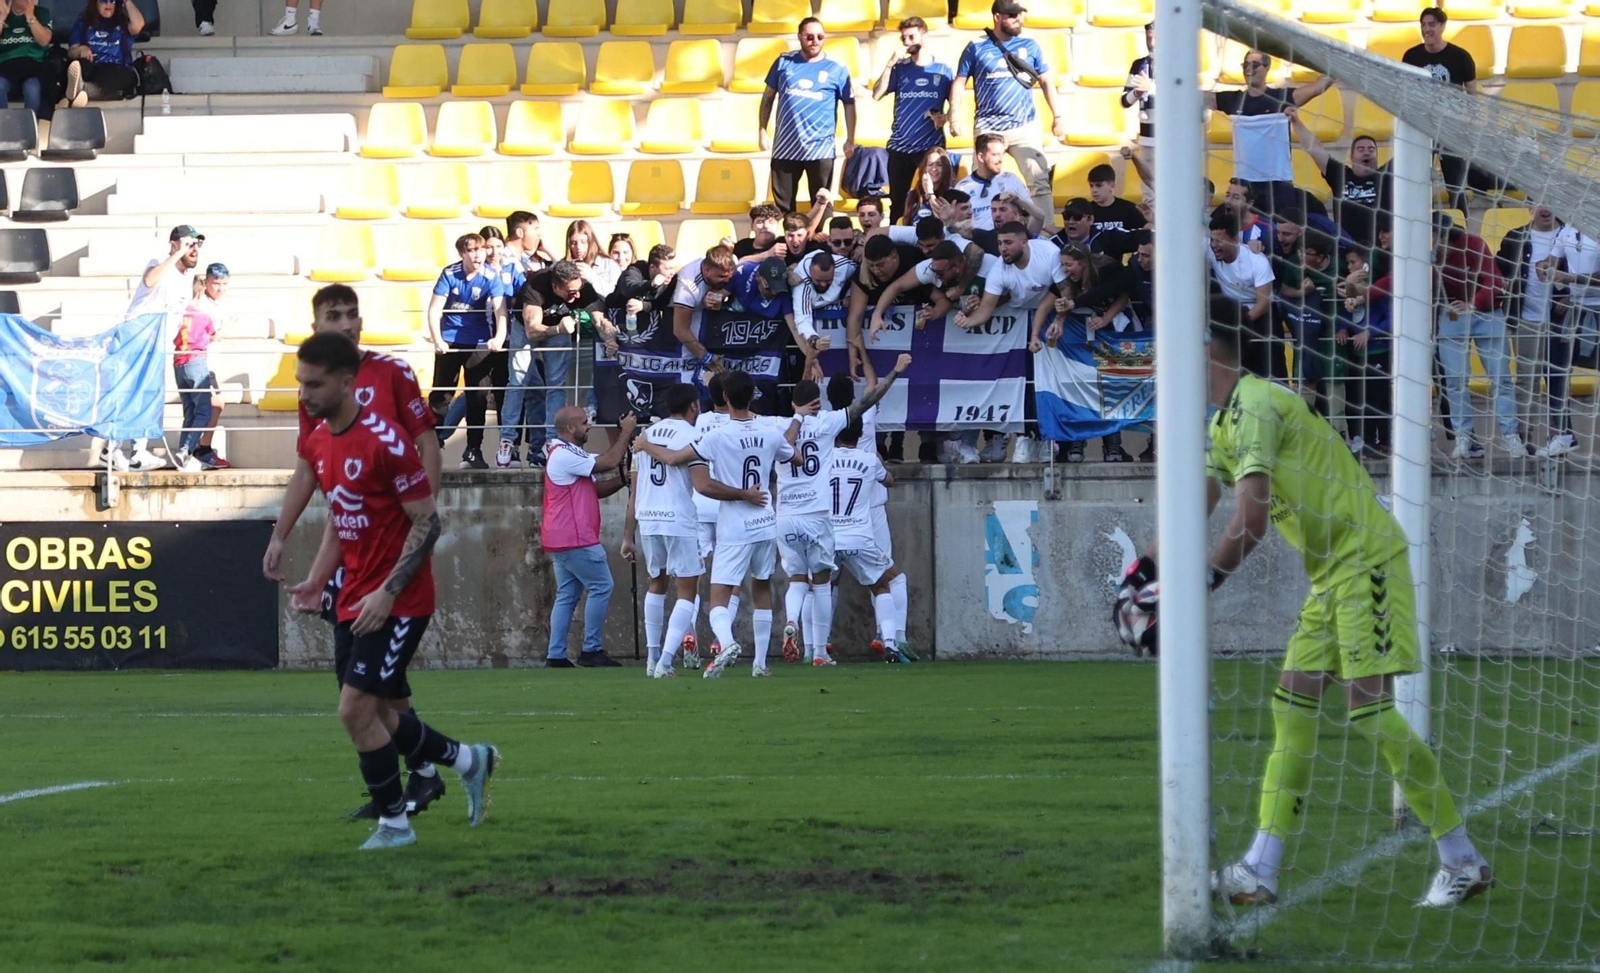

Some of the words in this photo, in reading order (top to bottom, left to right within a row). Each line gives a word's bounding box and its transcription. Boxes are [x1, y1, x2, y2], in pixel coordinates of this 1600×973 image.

[953, 404, 1010, 422] 1947
[740, 436, 764, 449] REINA
[650, 443, 668, 487] 5
[742, 455, 761, 490] 6
[829, 477, 863, 516] 17
[334, 511, 369, 528] rden
[6, 536, 152, 571] OBRAS
[1, 579, 159, 613] CIVILES
[11, 625, 59, 650] 615
[64, 625, 95, 650] 55
[101, 625, 132, 650] 03
[139, 625, 166, 649] 11
